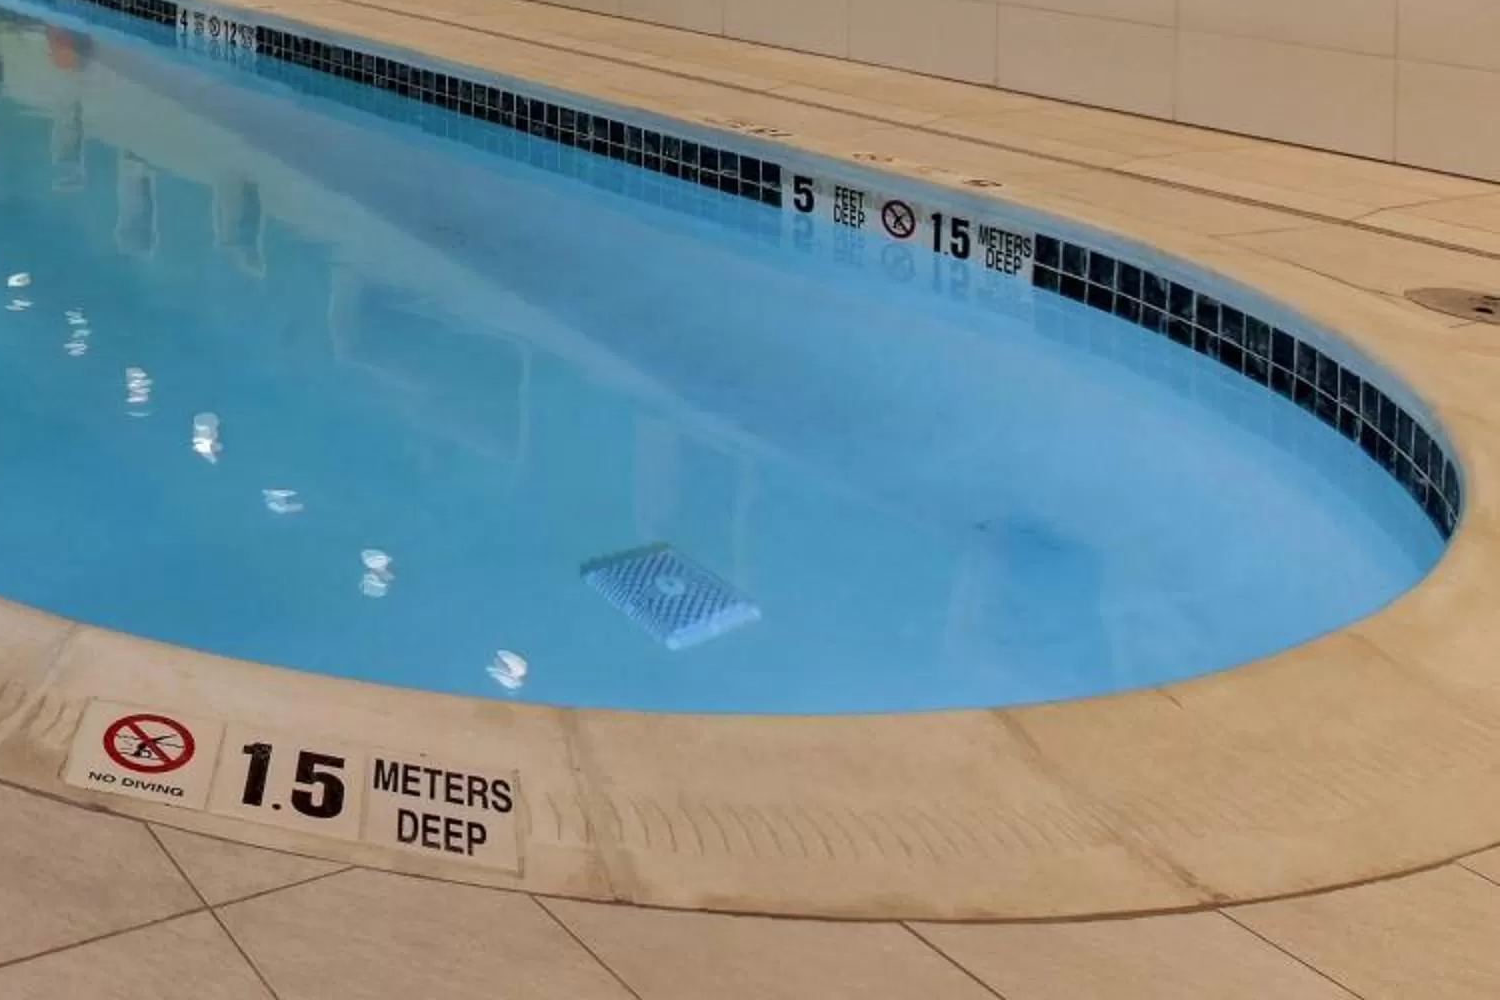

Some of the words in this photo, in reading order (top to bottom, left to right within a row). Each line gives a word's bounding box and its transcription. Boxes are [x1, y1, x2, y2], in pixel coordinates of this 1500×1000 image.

[793, 175, 815, 213] 5
[834, 185, 865, 210] FEET
[832, 206, 866, 228] DEEP
[931, 211, 971, 260] 1.5
[977, 224, 1033, 258] METERS
[985, 247, 1023, 275] DEEP
[87, 771, 117, 785] NO
[120, 779, 184, 797] DIVING
[241, 742, 346, 819] 1.5
[372, 758, 514, 814] METERS
[396, 808, 488, 856] DEEP
